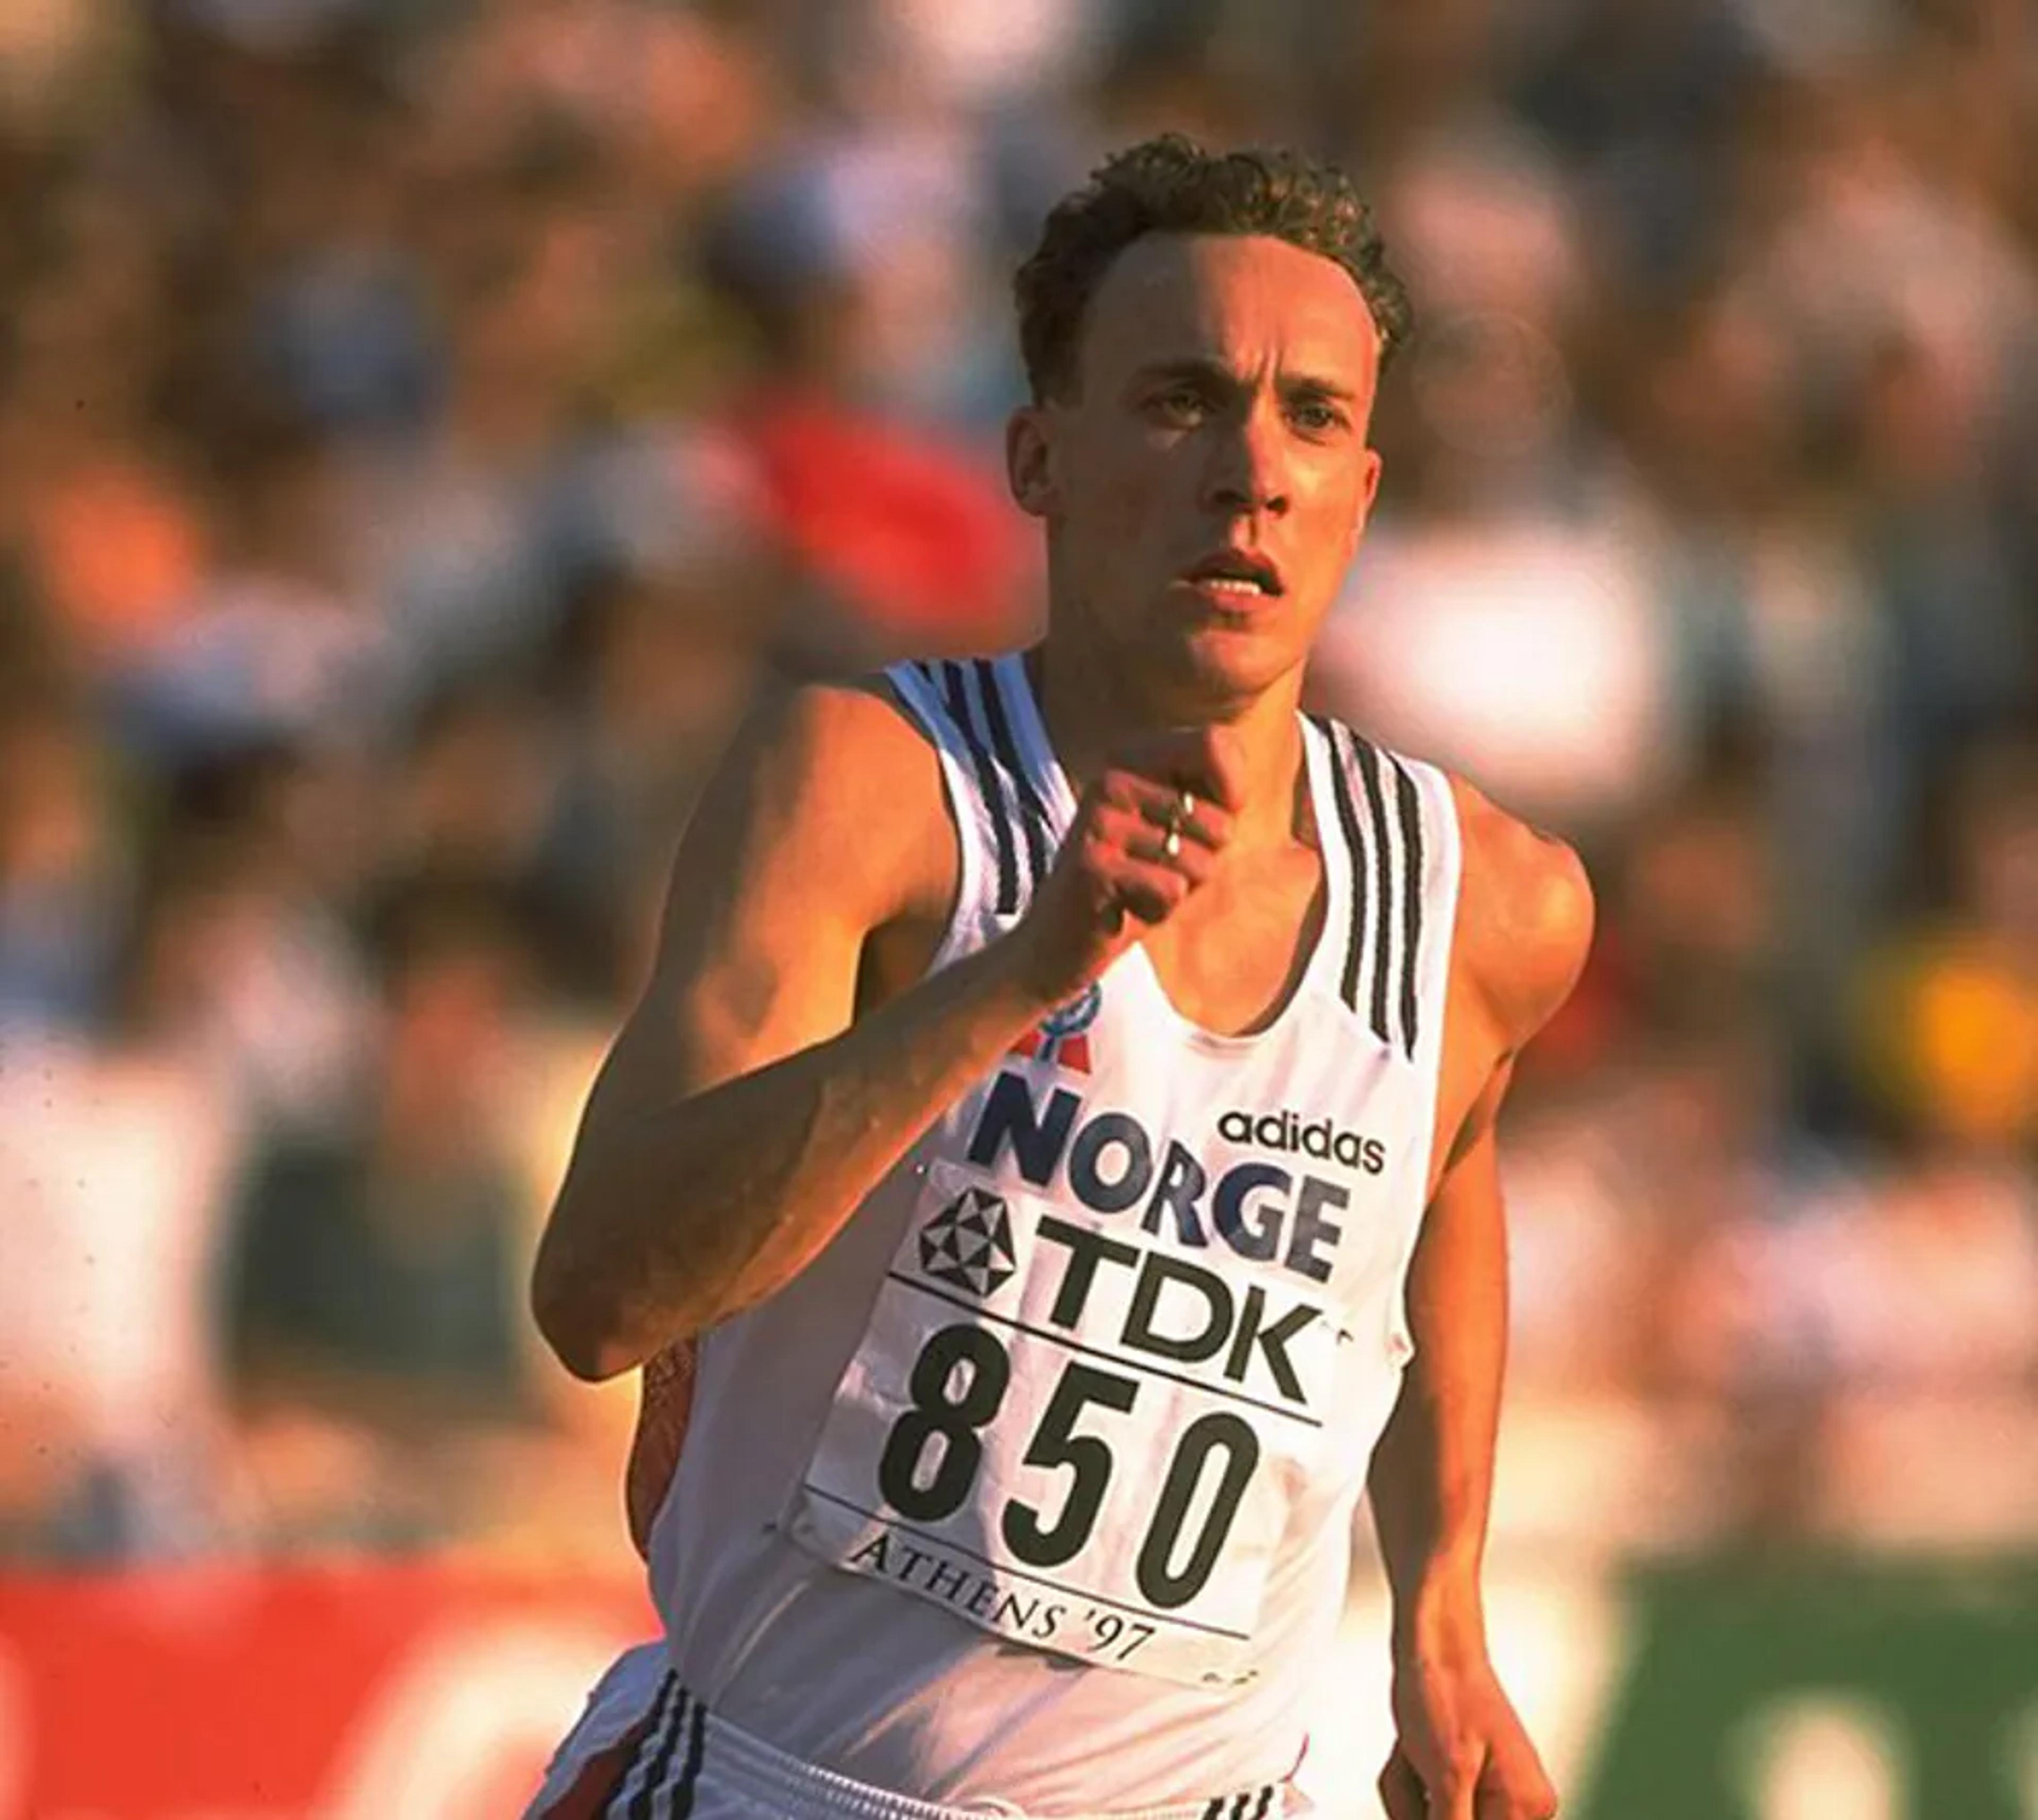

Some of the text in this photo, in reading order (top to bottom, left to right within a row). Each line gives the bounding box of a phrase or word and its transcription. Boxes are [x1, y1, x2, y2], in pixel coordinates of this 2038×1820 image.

[967, 1071, 1351, 1284] NORGE
[1217, 1110, 1386, 1175] adidas
[1035, 1214, 1324, 1405] TDK
[878, 1323, 1259, 1609] 850
[850, 1534, 1156, 1661] ATHENS '97
